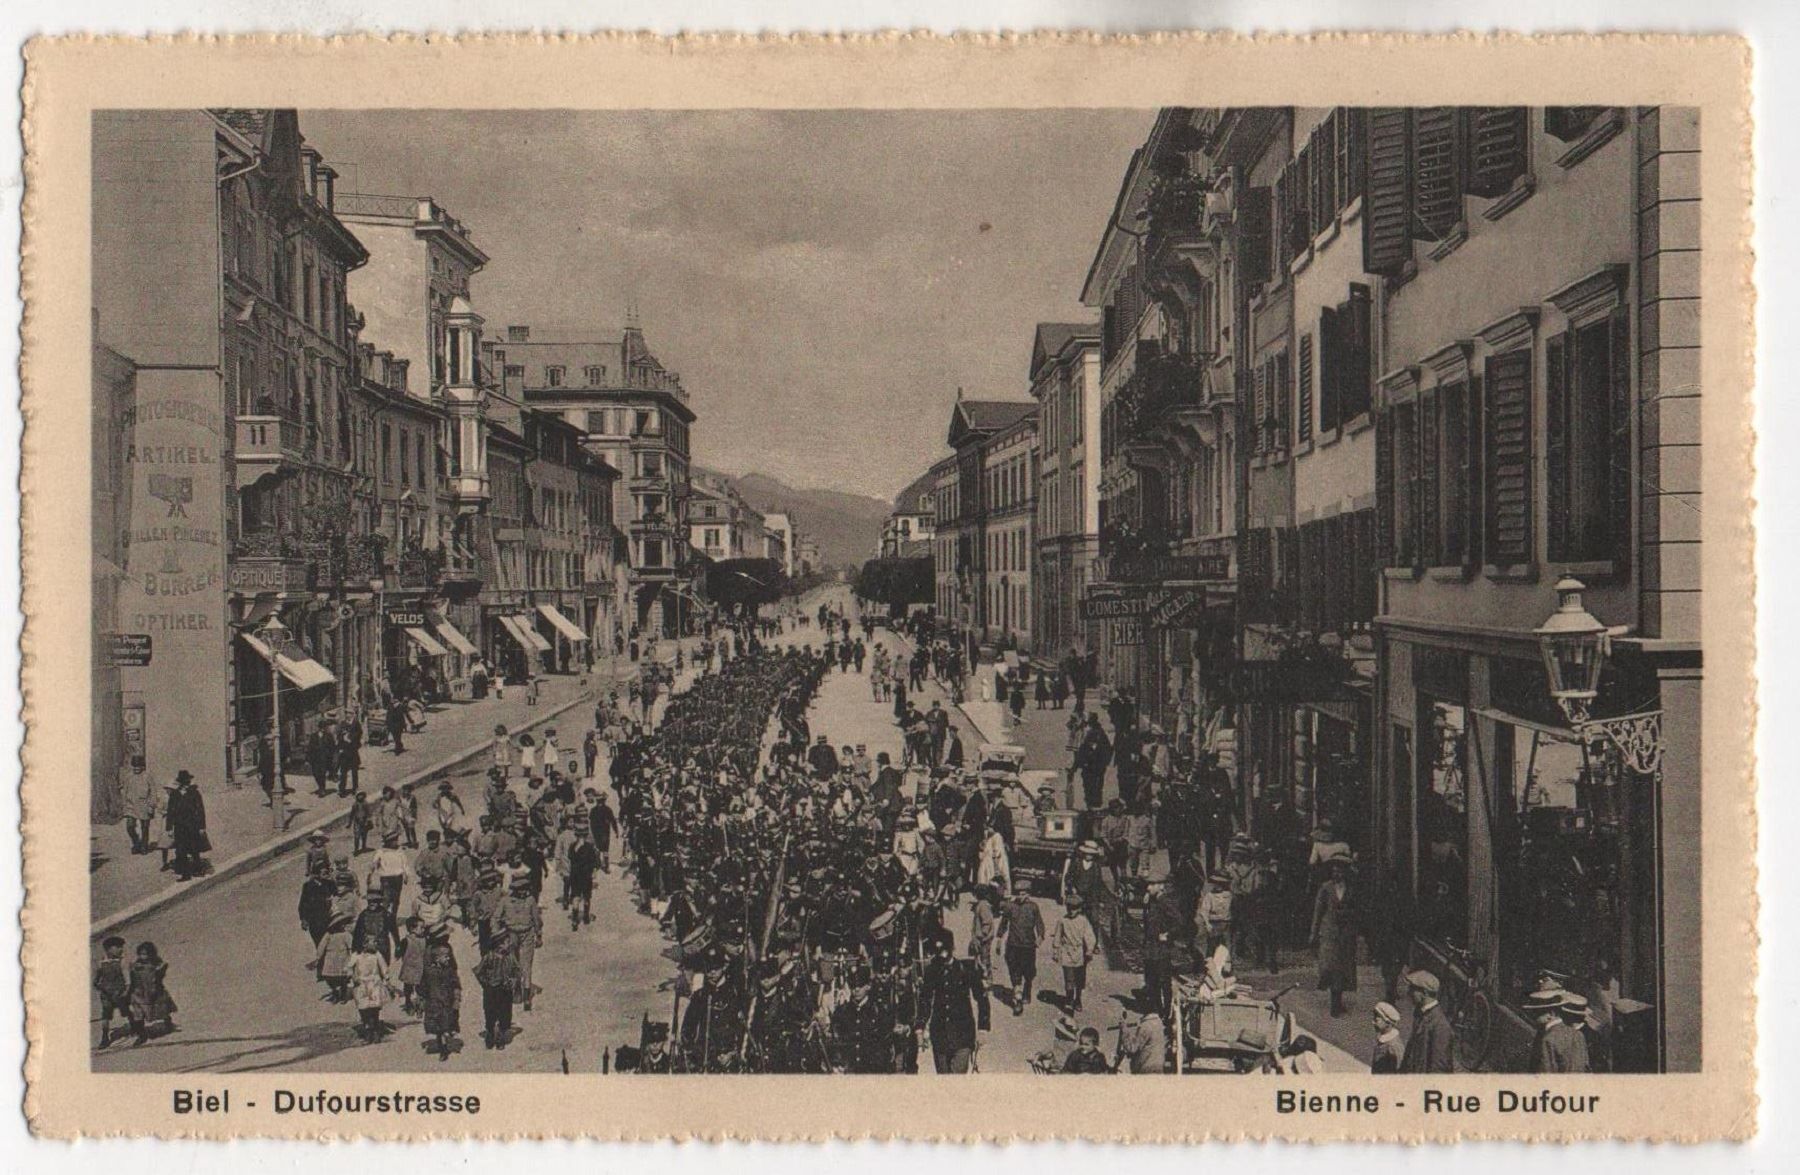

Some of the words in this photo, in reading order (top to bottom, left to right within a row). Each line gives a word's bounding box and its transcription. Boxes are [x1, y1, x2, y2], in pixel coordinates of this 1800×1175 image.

[230, 568, 282, 587] OPTIQUE
[390, 613, 424, 625] VELOS
[1114, 622, 1145, 645] EIER
